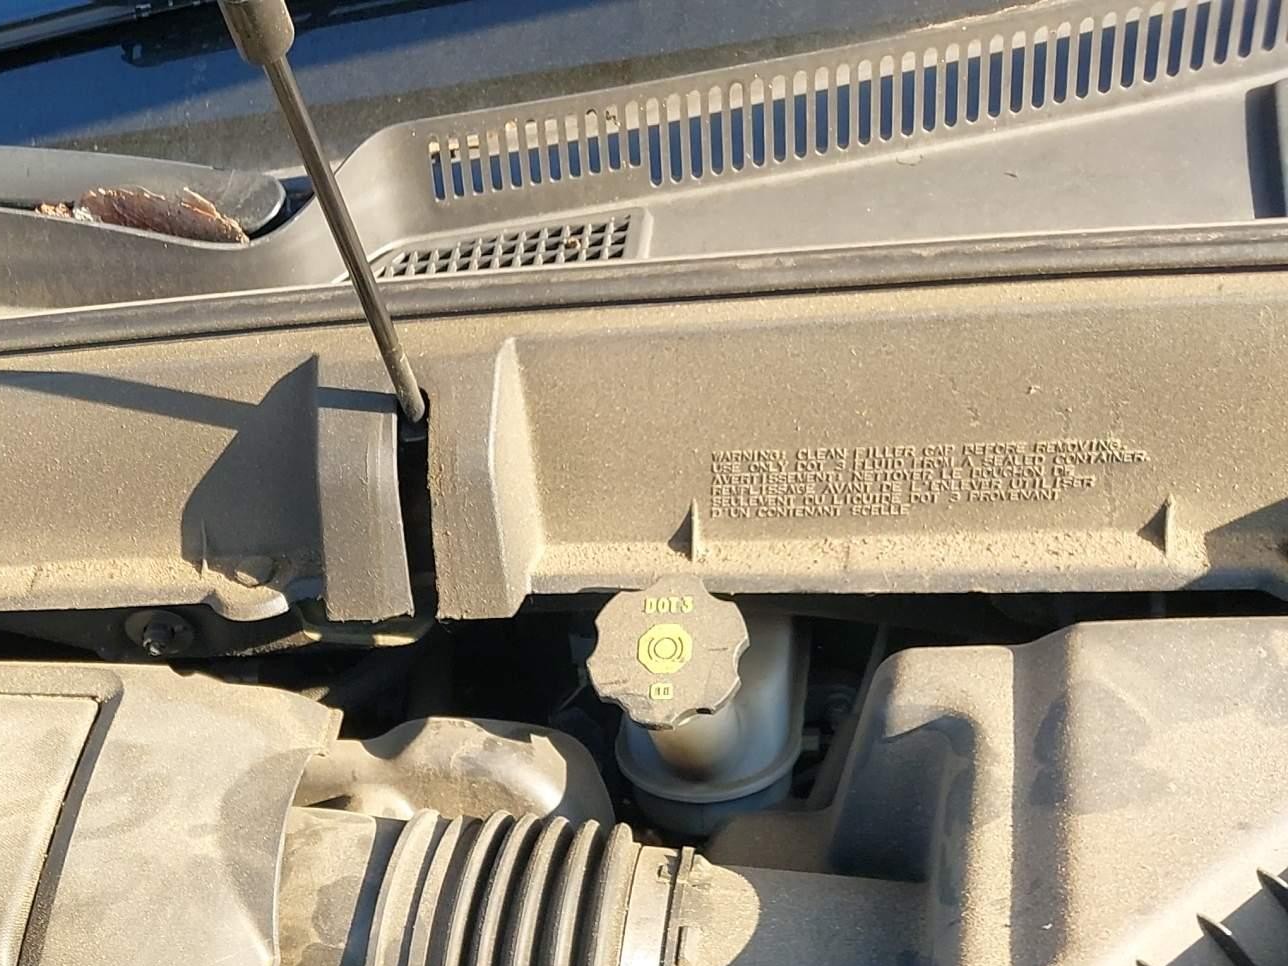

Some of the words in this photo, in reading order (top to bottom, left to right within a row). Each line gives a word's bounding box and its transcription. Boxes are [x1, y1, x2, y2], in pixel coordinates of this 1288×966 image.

[796, 447, 847, 460] CLEAN
[854, 446, 916, 459] FILLER
[962, 441, 1028, 455] BEFORE
[711, 461, 742, 473] USE
[748, 460, 789, 472] ONLY
[795, 460, 824, 472] DOT
[834, 459, 846, 472] 3
[853, 457, 904, 471] FLUID
[961, 455, 974, 468] A
[982, 453, 1045, 467] SEALED
[852, 469, 934, 482] NETTOYER
[939, 467, 963, 479] LE
[822, 482, 873, 495] AVANT
[879, 481, 902, 493] DE
[1009, 475, 1096, 490] UTILISER
[831, 492, 903, 506] LIQUIDE
[909, 491, 939, 504] DOT
[948, 490, 961, 503] 3
[756, 505, 841, 518] CONTENANT
[850, 503, 911, 516] SCELLE
